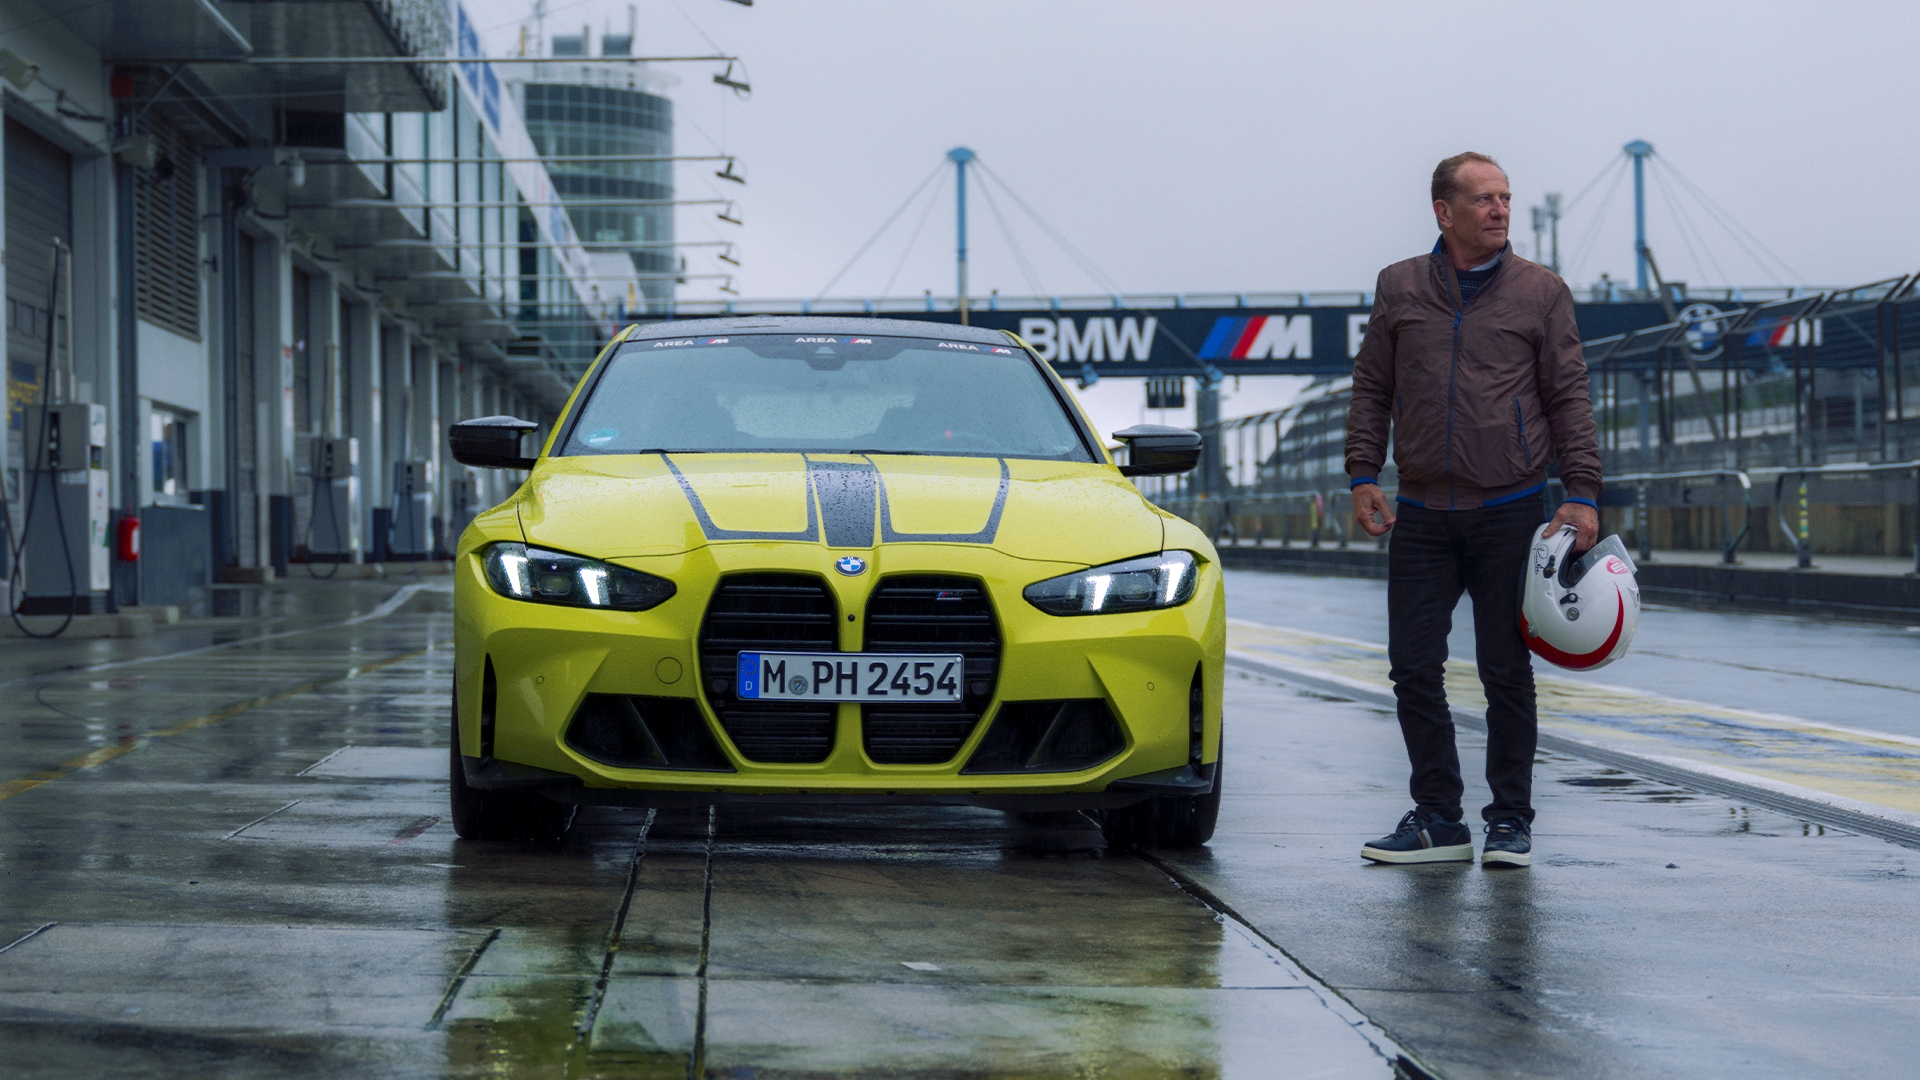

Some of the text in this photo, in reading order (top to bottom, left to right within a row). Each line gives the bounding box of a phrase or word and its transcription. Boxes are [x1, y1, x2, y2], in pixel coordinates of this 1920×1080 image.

[653, 340, 694, 348] AREA
[1019, 316, 1157, 362] BMW
[1246, 315, 1313, 360] M
[938, 342, 1012, 356] AREA M
[763, 659, 957, 696] M PH 2454
[744, 681, 753, 691] D
